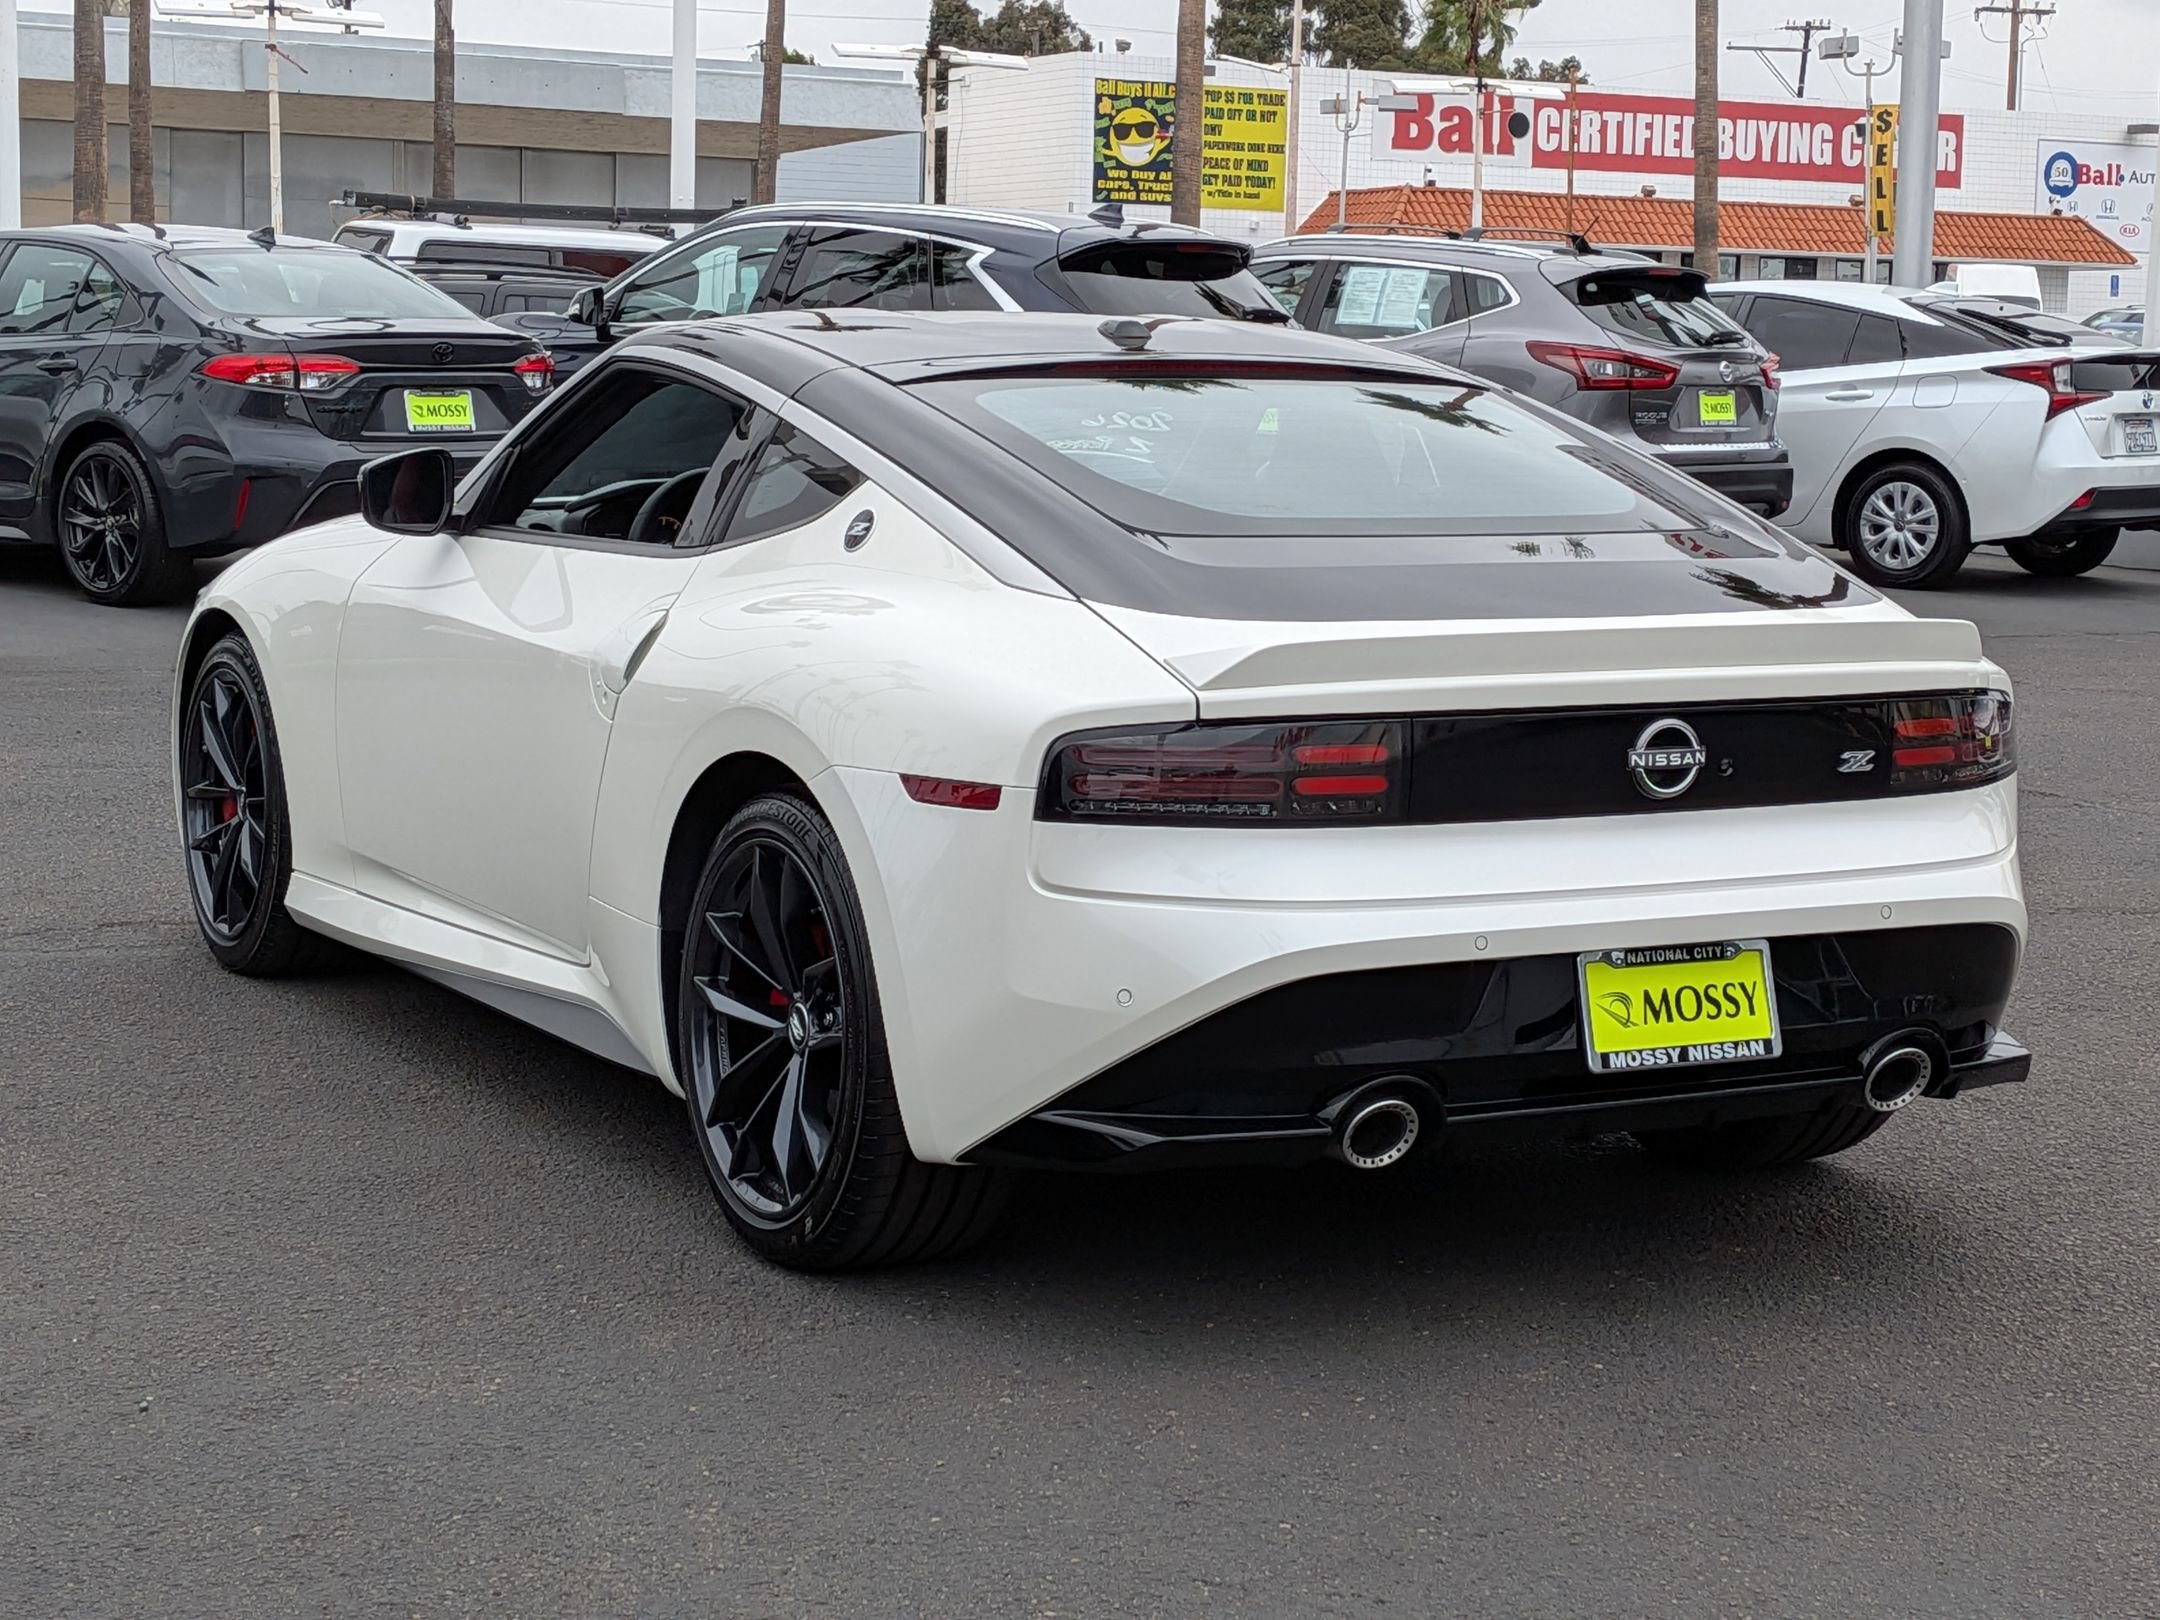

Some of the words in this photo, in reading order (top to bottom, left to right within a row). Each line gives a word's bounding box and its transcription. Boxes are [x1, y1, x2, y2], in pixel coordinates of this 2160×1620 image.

[1096, 79, 1116, 95] Ball
[1117, 81, 1143, 98] Buys
[1204, 90, 1222, 103] TOP
[1237, 91, 1254, 105] FOR
[1256, 93, 1286, 107] TRADE
[1204, 106, 1225, 120] PAID
[1227, 108, 1243, 121] OFF
[1245, 109, 1257, 122] OR
[1259, 110, 1278, 123] NOT
[1204, 123, 1223, 136] DMV
[1391, 91, 1516, 156] Ball
[1537, 106, 1695, 160] CERTIFIED
[1717, 118, 1834, 167] BUYING
[1202, 156, 1231, 169] PEACE
[1233, 158, 1244, 171] OF
[1246, 159, 1269, 172] MIND
[1107, 168, 1128, 179] We
[2077, 163, 2122, 186] Ball
[1137, 181, 1174, 191] Truc
[1202, 174, 1220, 186] GET
[1222, 174, 1243, 187] PAID
[1244, 175, 1276, 190] TODAY!
[1109, 190, 1137, 201] and
[426, 404, 468, 418] MOSSY
[1630, 752, 1706, 768] NISSAN
[1626, 949, 1690, 964] NATIONAL
[1693, 945, 1724, 960] CITY
[1643, 980, 1758, 1025] MOSSY
[1609, 1047, 1681, 1069] MOSSY
[1687, 1040, 1766, 1062] NISSAN
